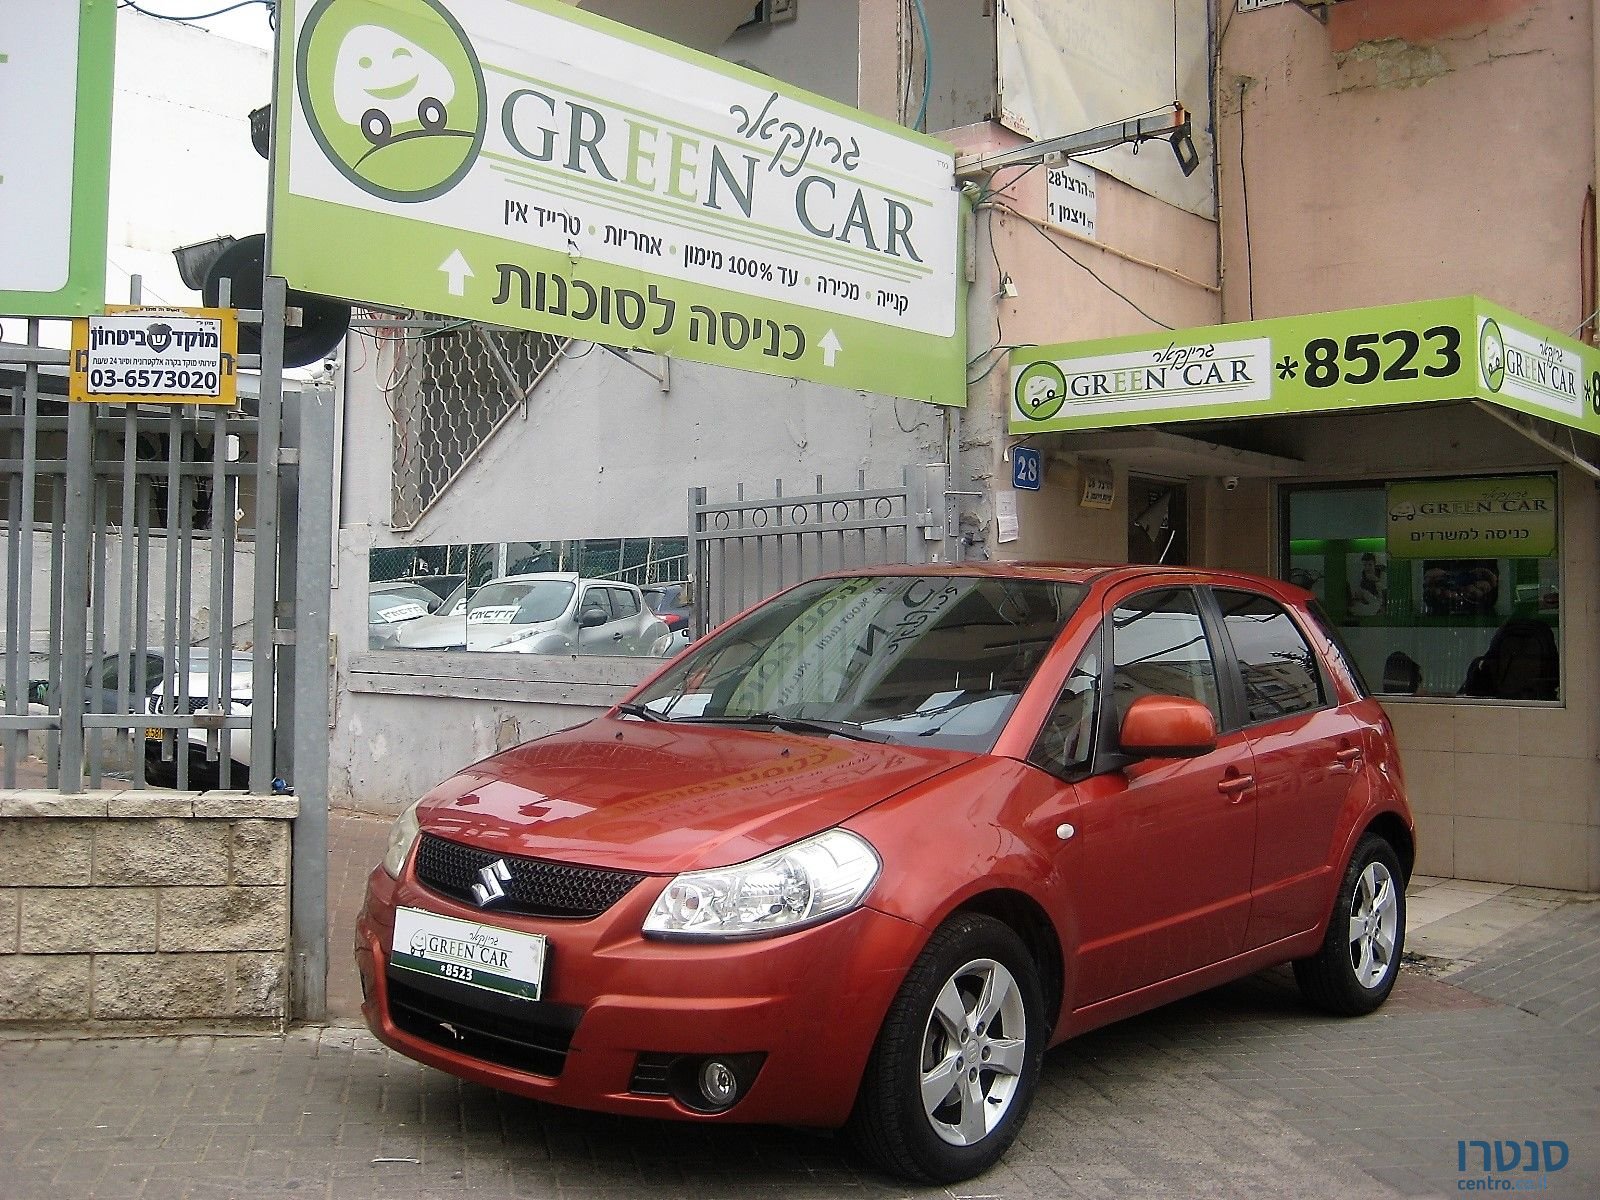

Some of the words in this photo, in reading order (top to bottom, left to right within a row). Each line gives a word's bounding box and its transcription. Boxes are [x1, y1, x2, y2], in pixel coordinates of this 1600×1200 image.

[729, 92, 860, 178] גרינקאר
[501, 88, 760, 218] GREEN
[795, 175, 923, 263] CAR
[504, 199, 529, 225] אין
[533, 206, 581, 236] טרייד
[1049, 202, 1055, 216] 1
[1059, 204, 1086, 226] ויצמן
[603, 225, 663, 257] אחריות
[684, 244, 723, 270] מימון
[728, 255, 773, 282] 100%
[777, 266, 799, 287] עד
[817, 275, 860, 300] מכירה
[491, 263, 676, 336] לסוכנות
[876, 289, 909, 316] קנייה
[90, 326, 147, 350] ביטחון
[172, 327, 218, 352] מוקד
[689, 304, 806, 361] כניסה
[109, 357, 117, 365] 24
[1152, 341, 1215, 371] גרינקאר
[90, 368, 217, 390] 03-6573020
[1070, 367, 1168, 397] GREEN
[1182, 359, 1253, 386] CAR
[1506, 349, 1546, 385] GREEN
[1551, 366, 1576, 395] CAR
[1017, 455, 1037, 482] 28
[1420, 501, 1492, 515] GREEN
[1502, 499, 1548, 512] CAR
[1410, 527, 1479, 542] למשרדים
[1485, 528, 1530, 540] כניסה
[429, 937, 475, 959] GREEN
[480, 947, 509, 968] CAR
